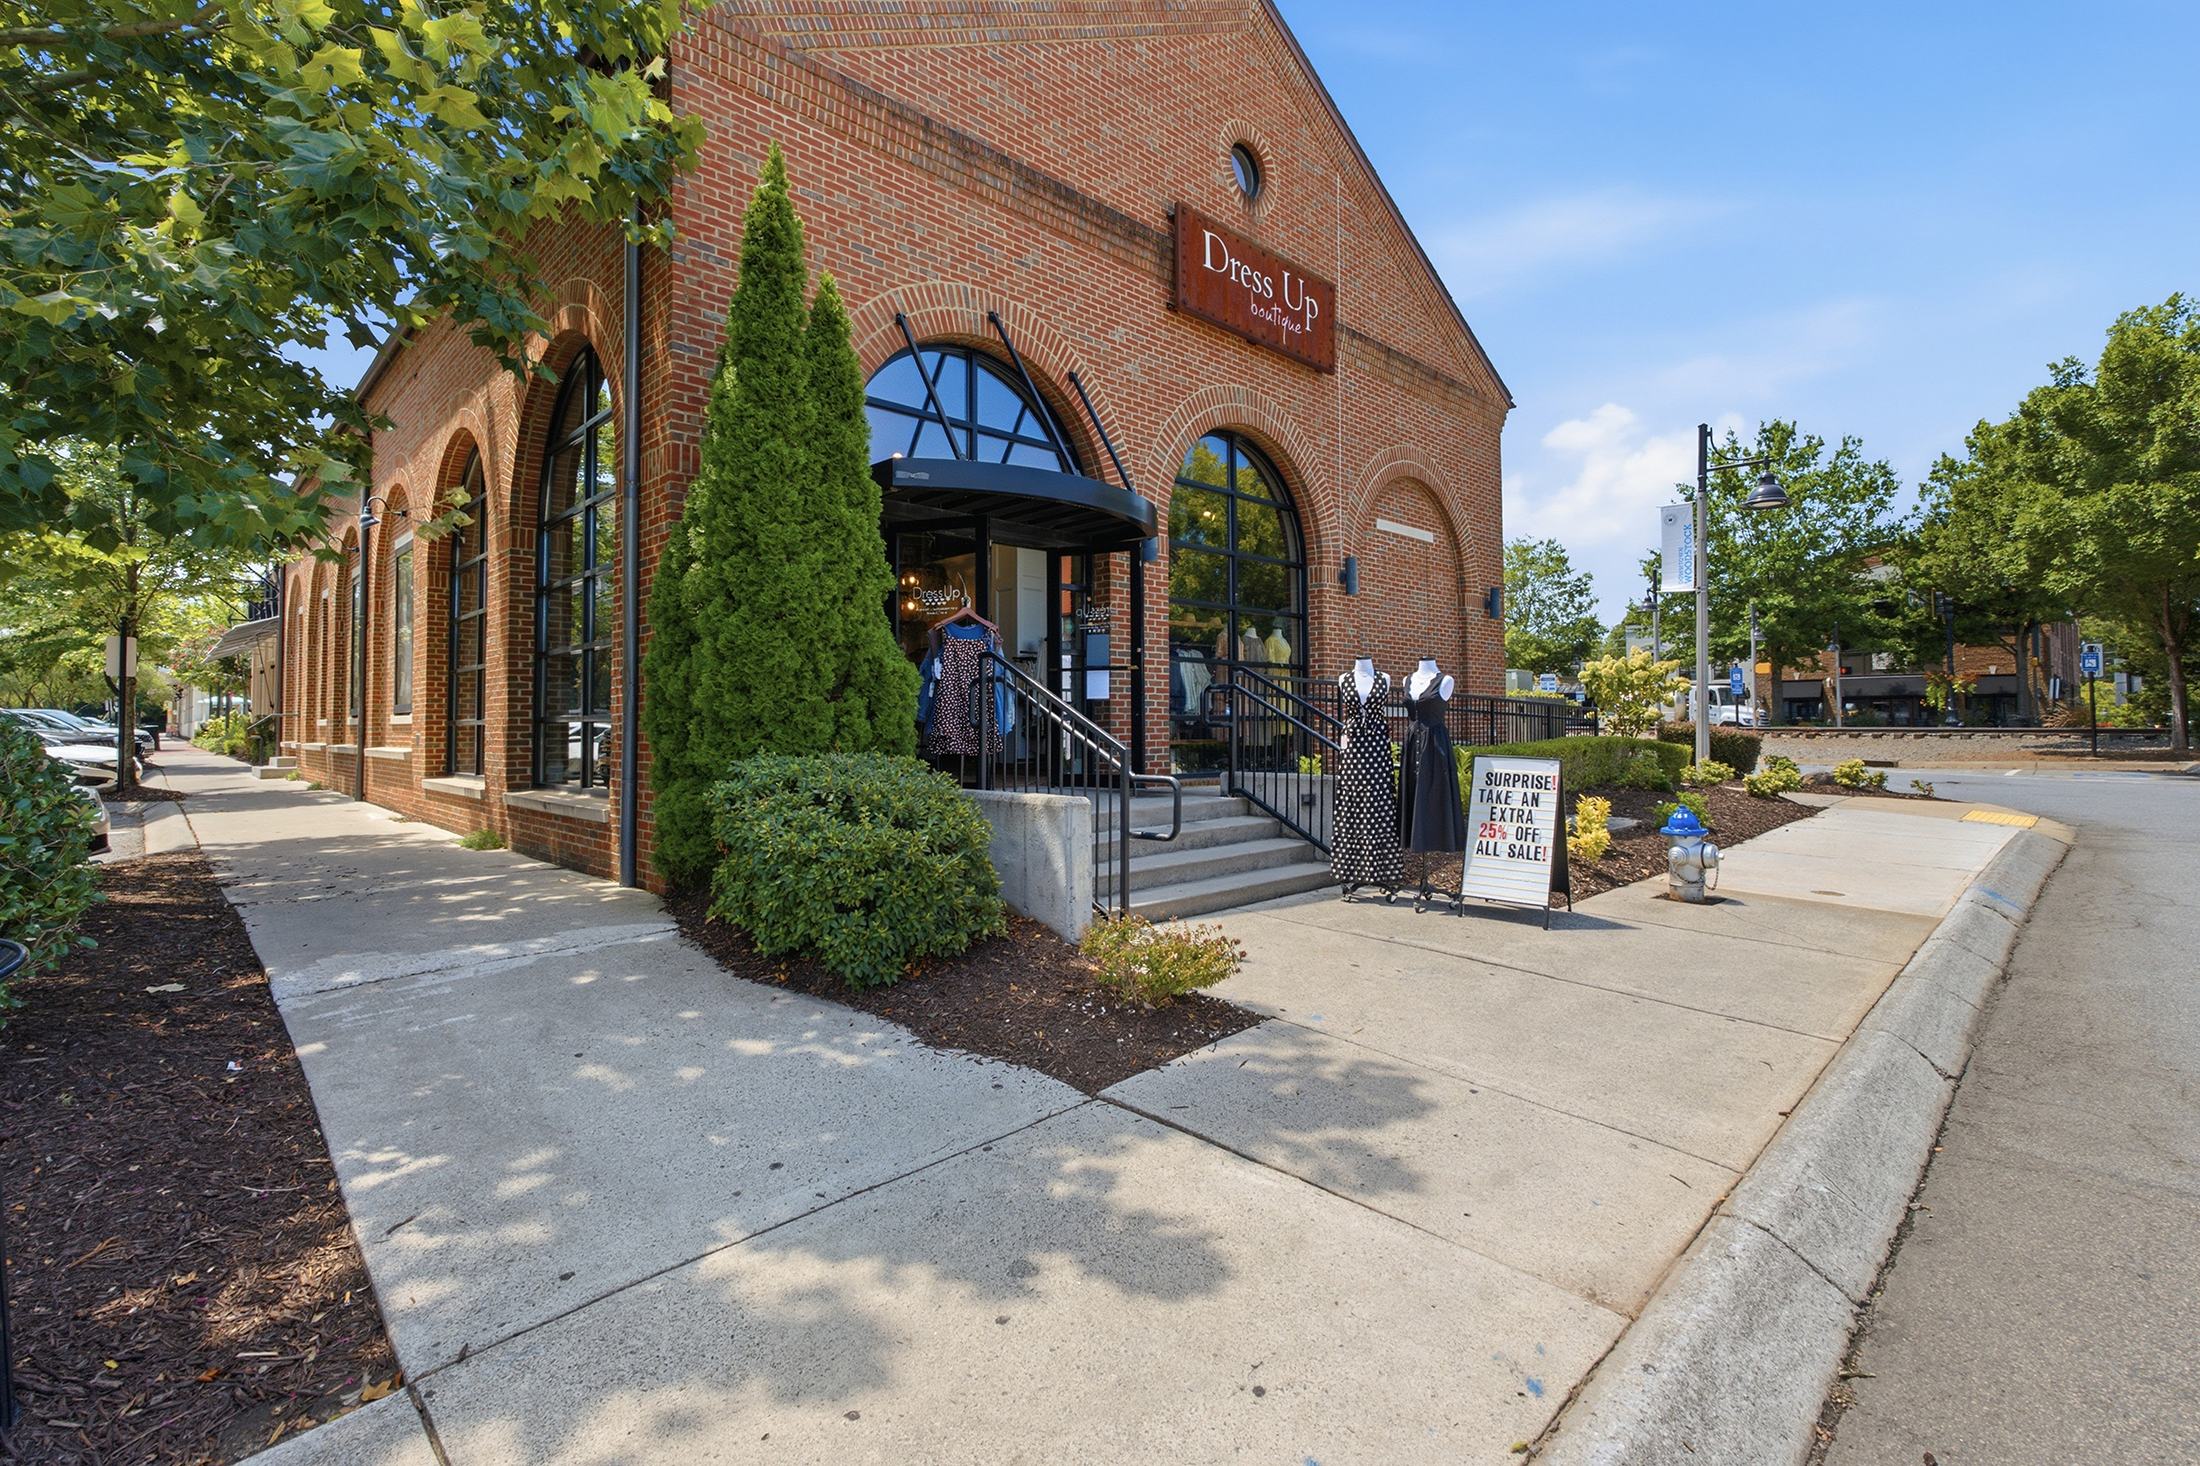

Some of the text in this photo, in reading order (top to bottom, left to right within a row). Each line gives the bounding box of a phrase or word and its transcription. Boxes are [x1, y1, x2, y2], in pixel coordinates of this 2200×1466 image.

[1202, 229, 1319, 333] Dress Up
[1250, 290, 1302, 345] boutique
[1683, 523, 1692, 584] WOODSTOCK
[1485, 771, 1556, 791] SURPRISE!
[1479, 788, 1539, 807] TAKE AN
[1489, 806, 1533, 824] EXTRA
[1479, 822, 1540, 842] 25% OFF
[1476, 840, 1547, 862] ALL SALE!
